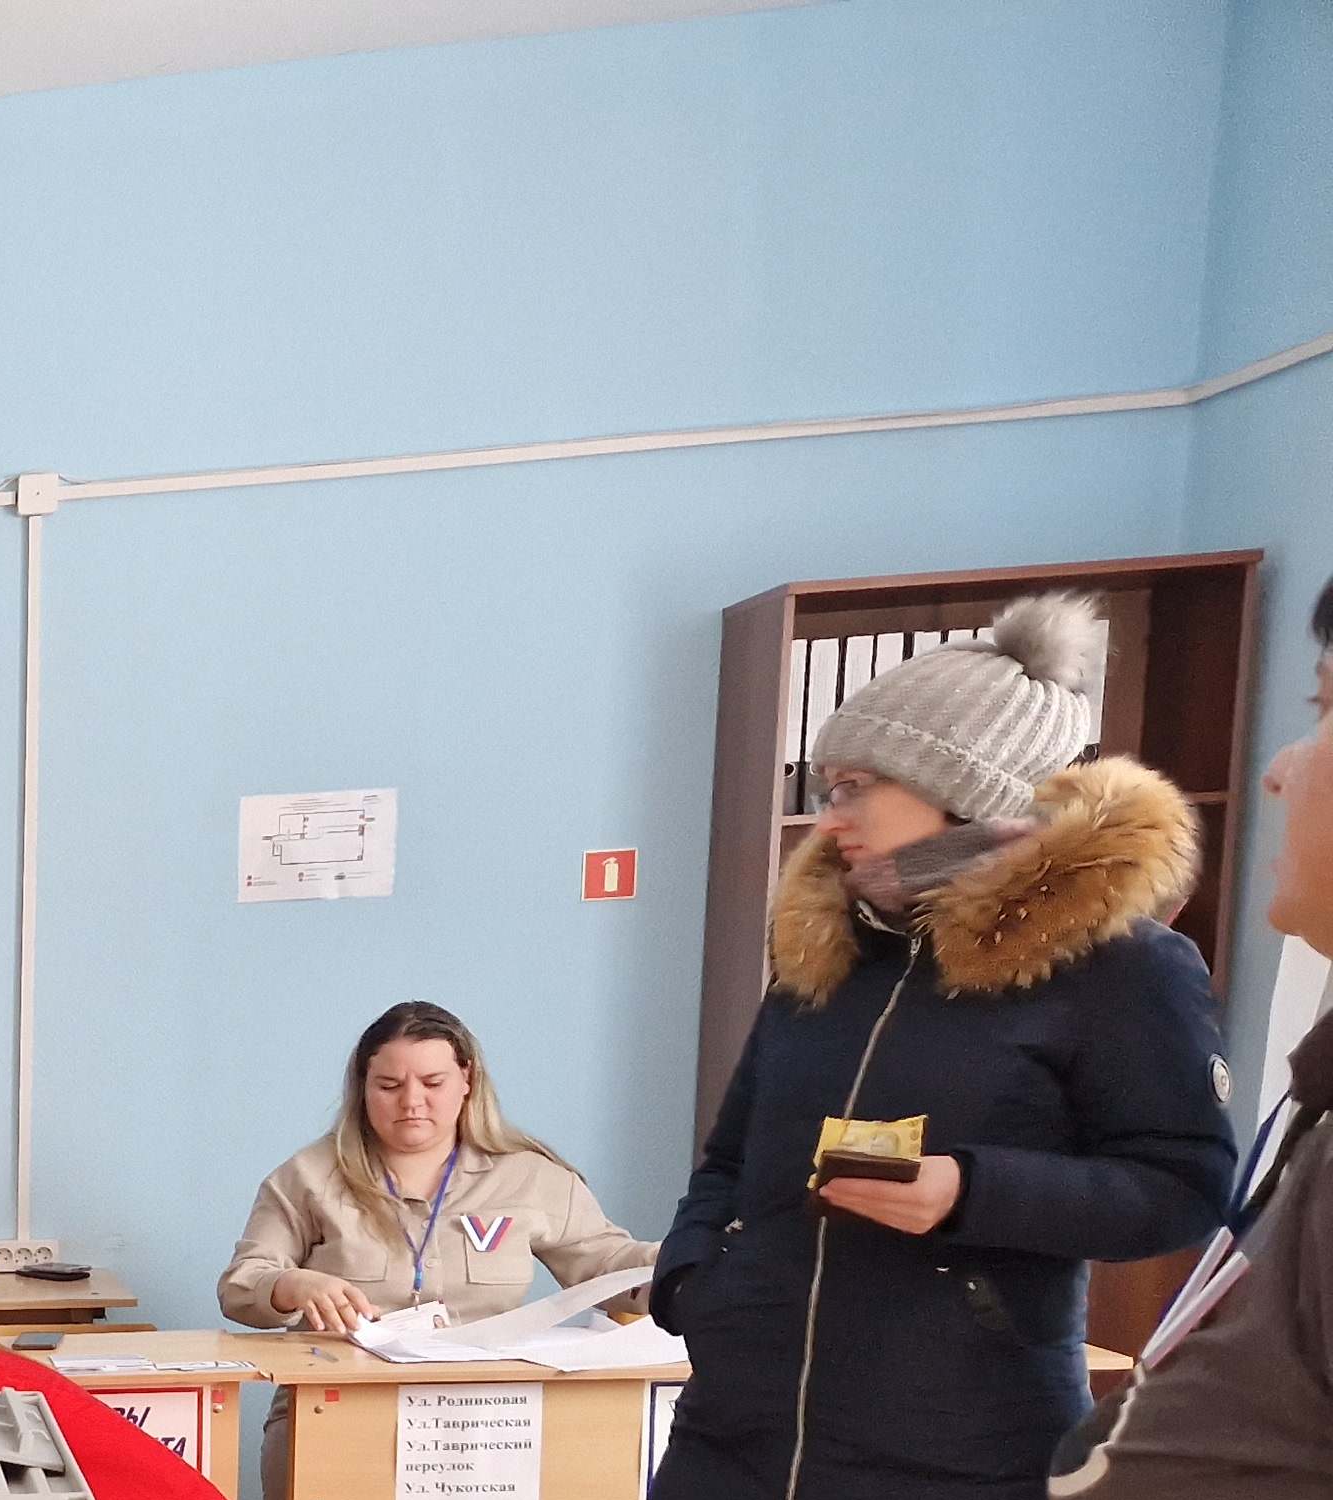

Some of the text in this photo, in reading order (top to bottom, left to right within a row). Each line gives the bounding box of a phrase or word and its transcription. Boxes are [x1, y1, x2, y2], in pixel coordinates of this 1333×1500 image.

[406, 1394, 528, 1407] Ул. Родниковая
[154, 1437, 187, 1458] ТА
[405, 1462, 475, 1474] переулок
[404, 1482, 515, 1496] Ул. Чукотская
